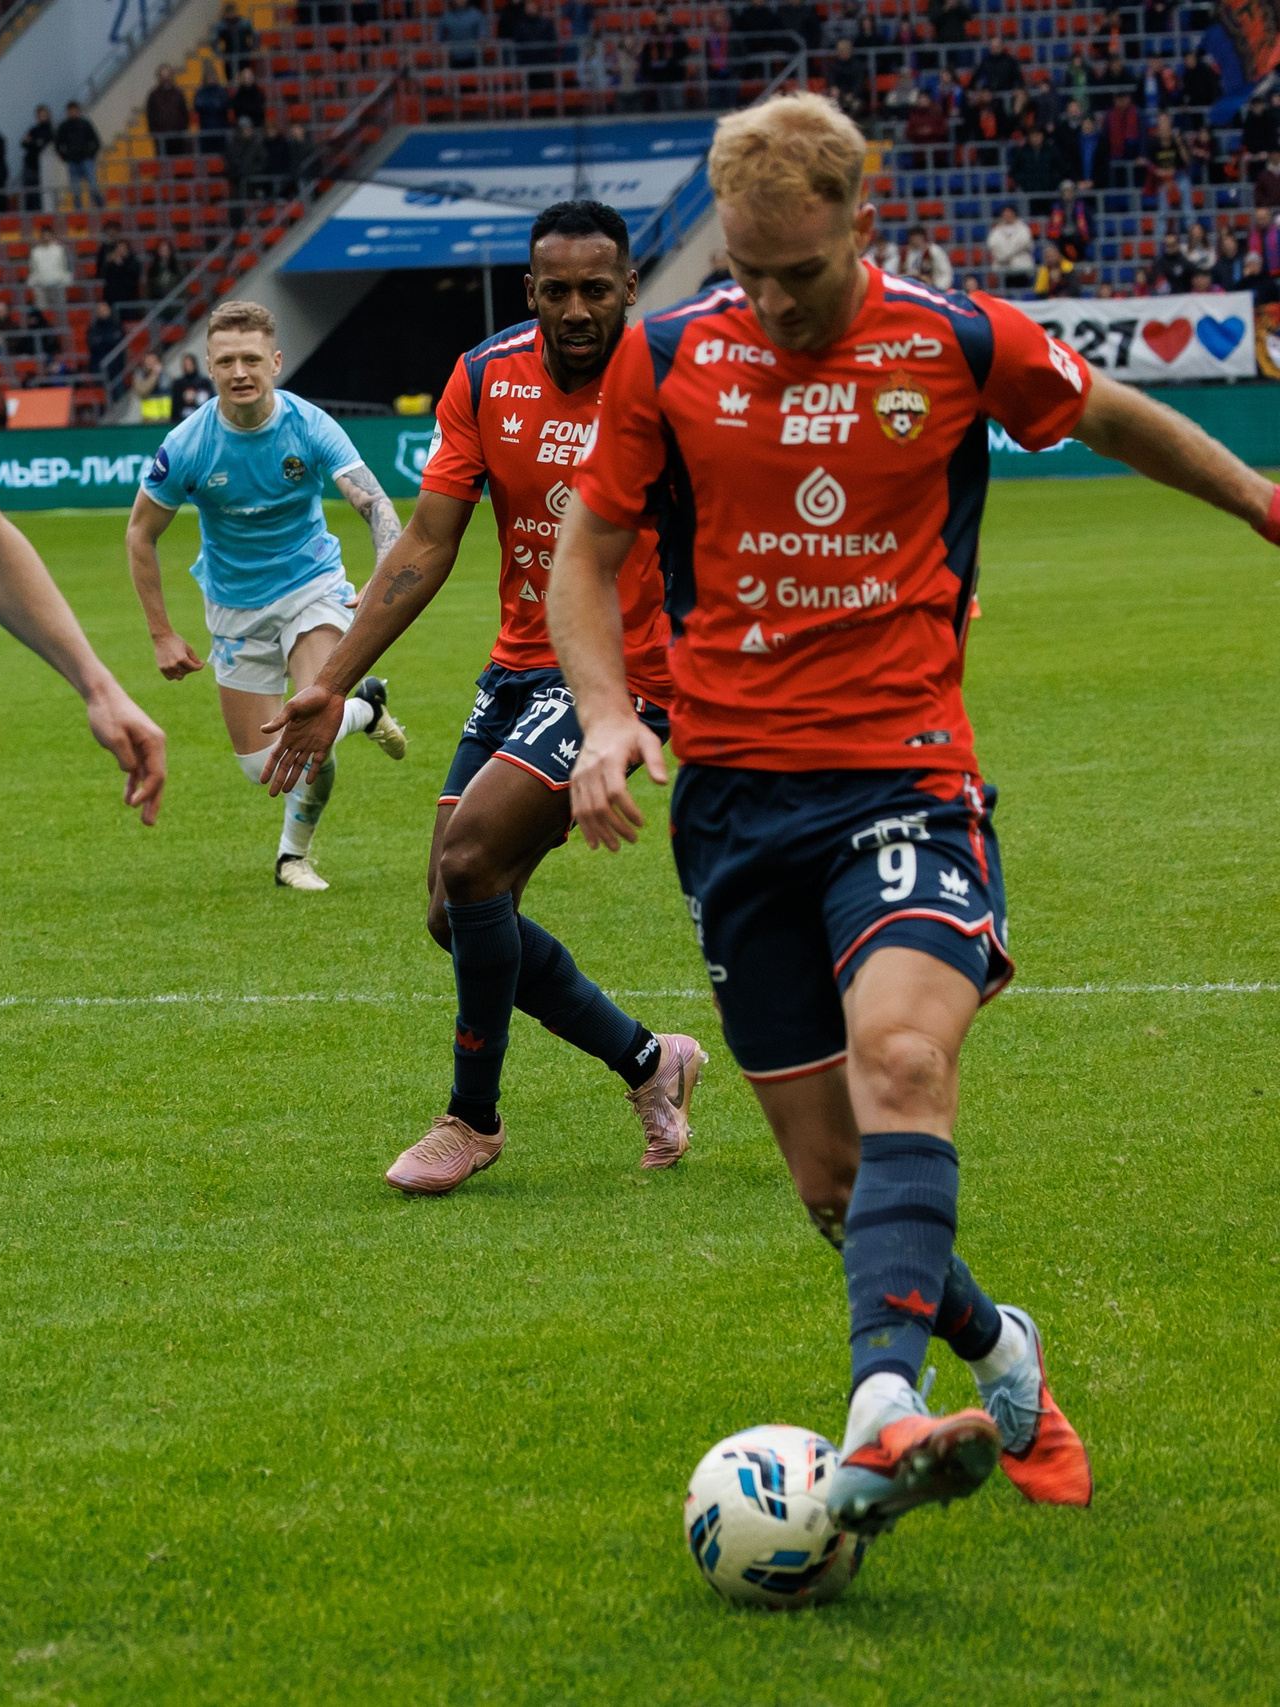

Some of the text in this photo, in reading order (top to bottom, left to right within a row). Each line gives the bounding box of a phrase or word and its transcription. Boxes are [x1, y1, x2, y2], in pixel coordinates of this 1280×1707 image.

[726, 343, 776, 366] ПСБ
[511, 384, 542, 399] ПСБ
[779, 382, 857, 414] FON
[539, 420, 592, 444] FON
[780, 414, 859, 445] BET
[536, 442, 587, 467] BET
[513, 517, 563, 538] APOT
[737, 531, 898, 557] APOTHEKA
[776, 576, 898, 609] билайн
[508, 699, 569, 745] 27
[877, 842, 917, 903] 9
